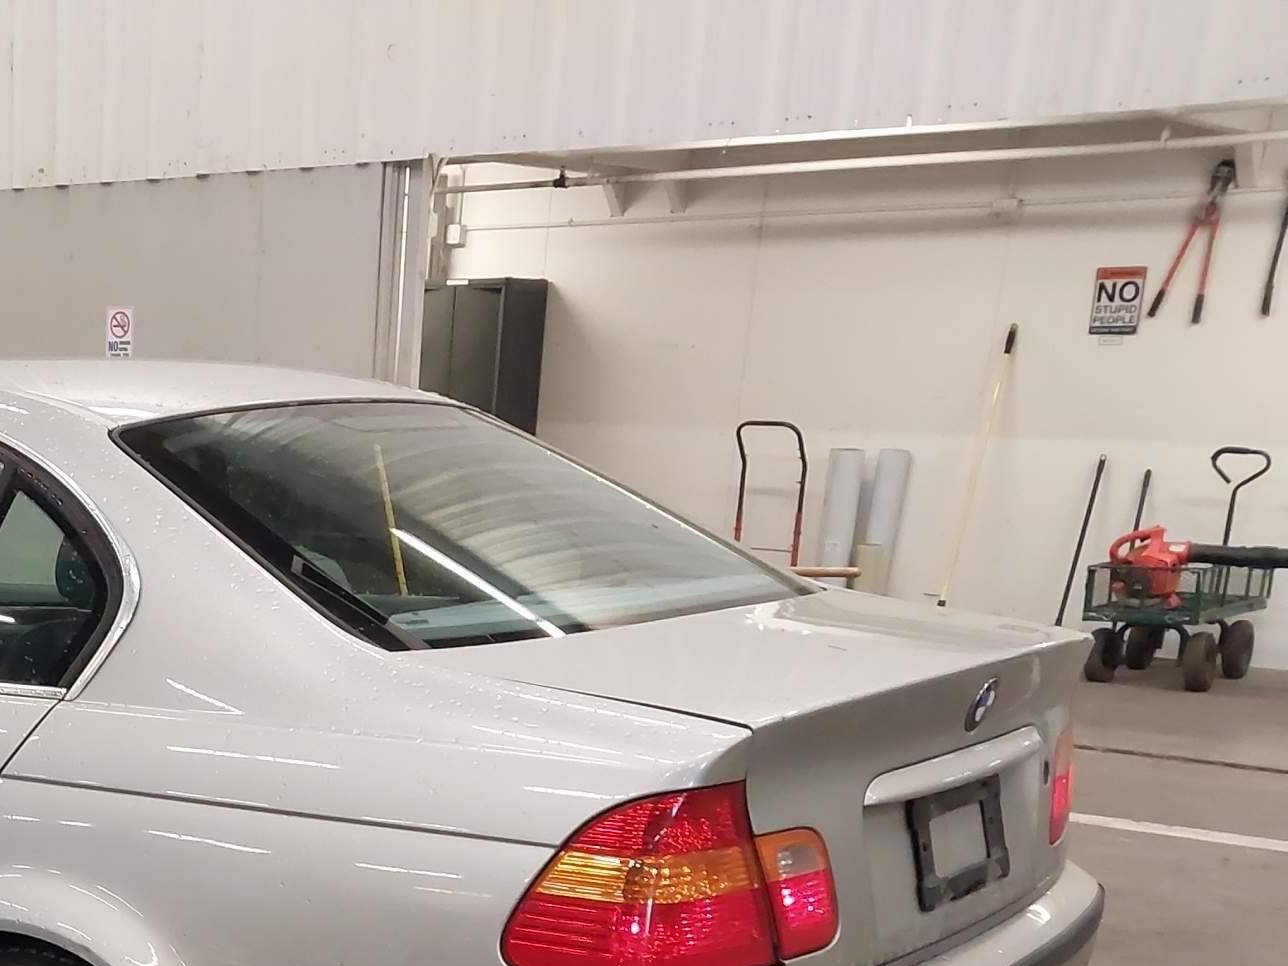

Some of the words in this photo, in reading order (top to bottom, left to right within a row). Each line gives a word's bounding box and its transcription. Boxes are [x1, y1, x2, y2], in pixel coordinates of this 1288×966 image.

[1097, 281, 1140, 303] NO
[1095, 304, 1137, 315] STUPID
[1093, 315, 1136, 324] PEOPLE
[108, 340, 119, 352] NO
